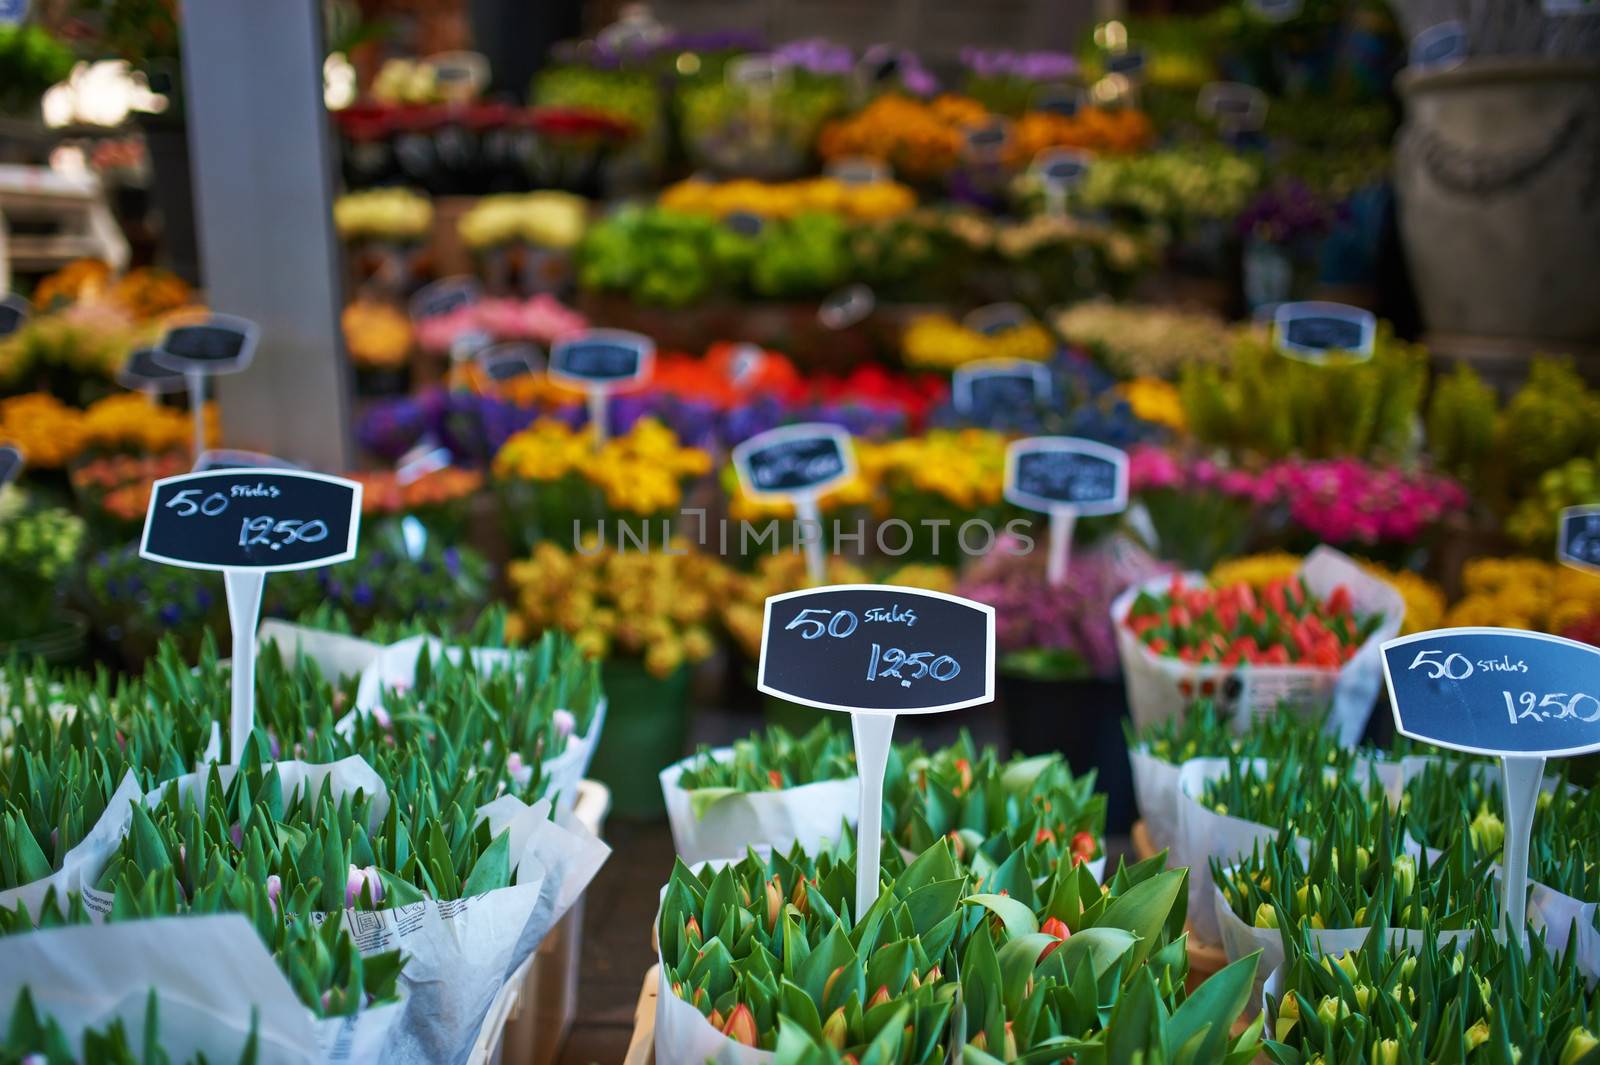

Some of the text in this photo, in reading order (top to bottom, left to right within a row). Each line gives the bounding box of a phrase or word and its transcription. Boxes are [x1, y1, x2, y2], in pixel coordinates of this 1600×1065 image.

[165, 489, 229, 517] 50
[784, 608, 859, 641] 50
[1408, 650, 1475, 680] 50
